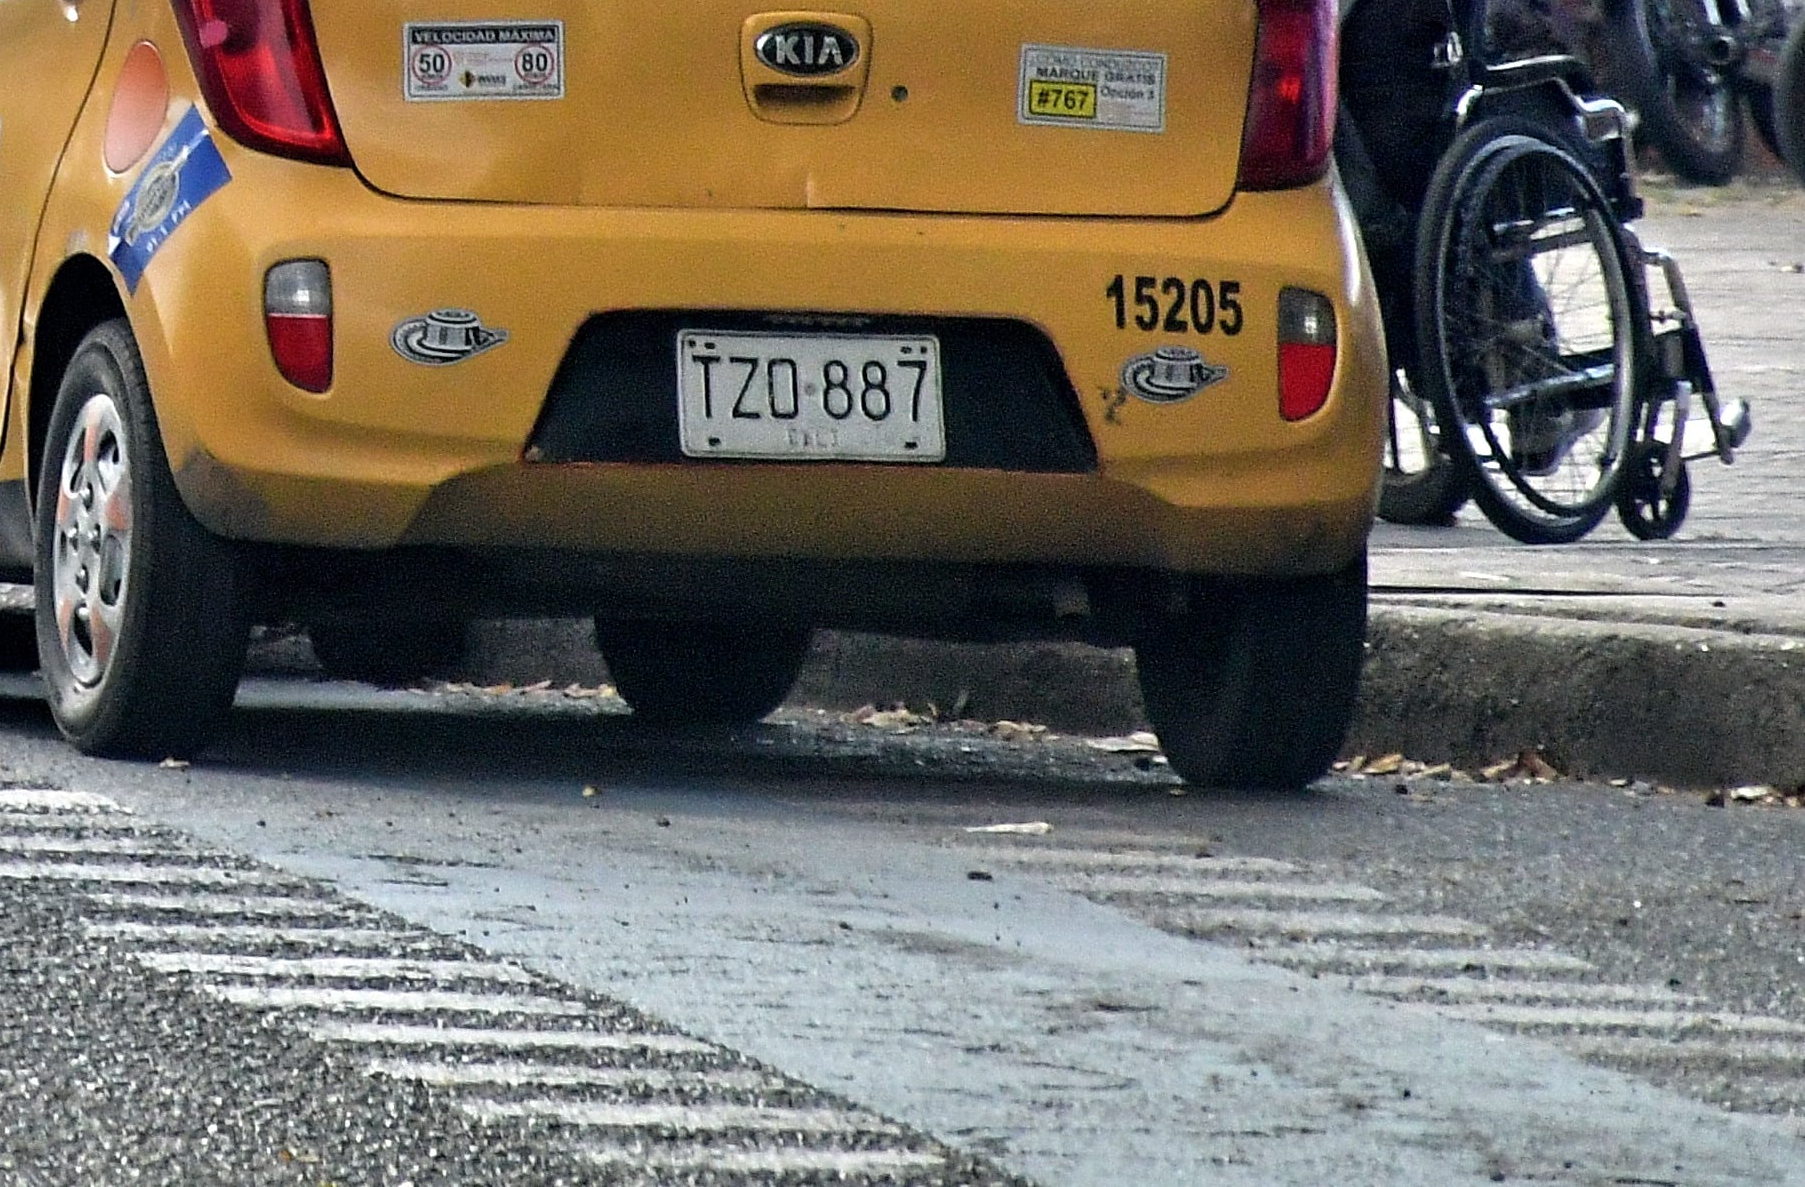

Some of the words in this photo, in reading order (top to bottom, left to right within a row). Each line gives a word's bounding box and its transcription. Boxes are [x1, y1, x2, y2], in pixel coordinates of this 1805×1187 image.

[413, 30, 496, 43] VELOCIDAD
[776, 34, 846, 66] KIA
[419, 53, 445, 73] 50
[522, 52, 548, 73] 80
[1036, 66, 1099, 81] MARQUE
[1104, 71, 1156, 86] GRATIS
[1038, 88, 1089, 110] #767
[1106, 274, 1244, 336] 15205
[691, 355, 799, 420] TZO
[822, 359, 927, 423] 887
